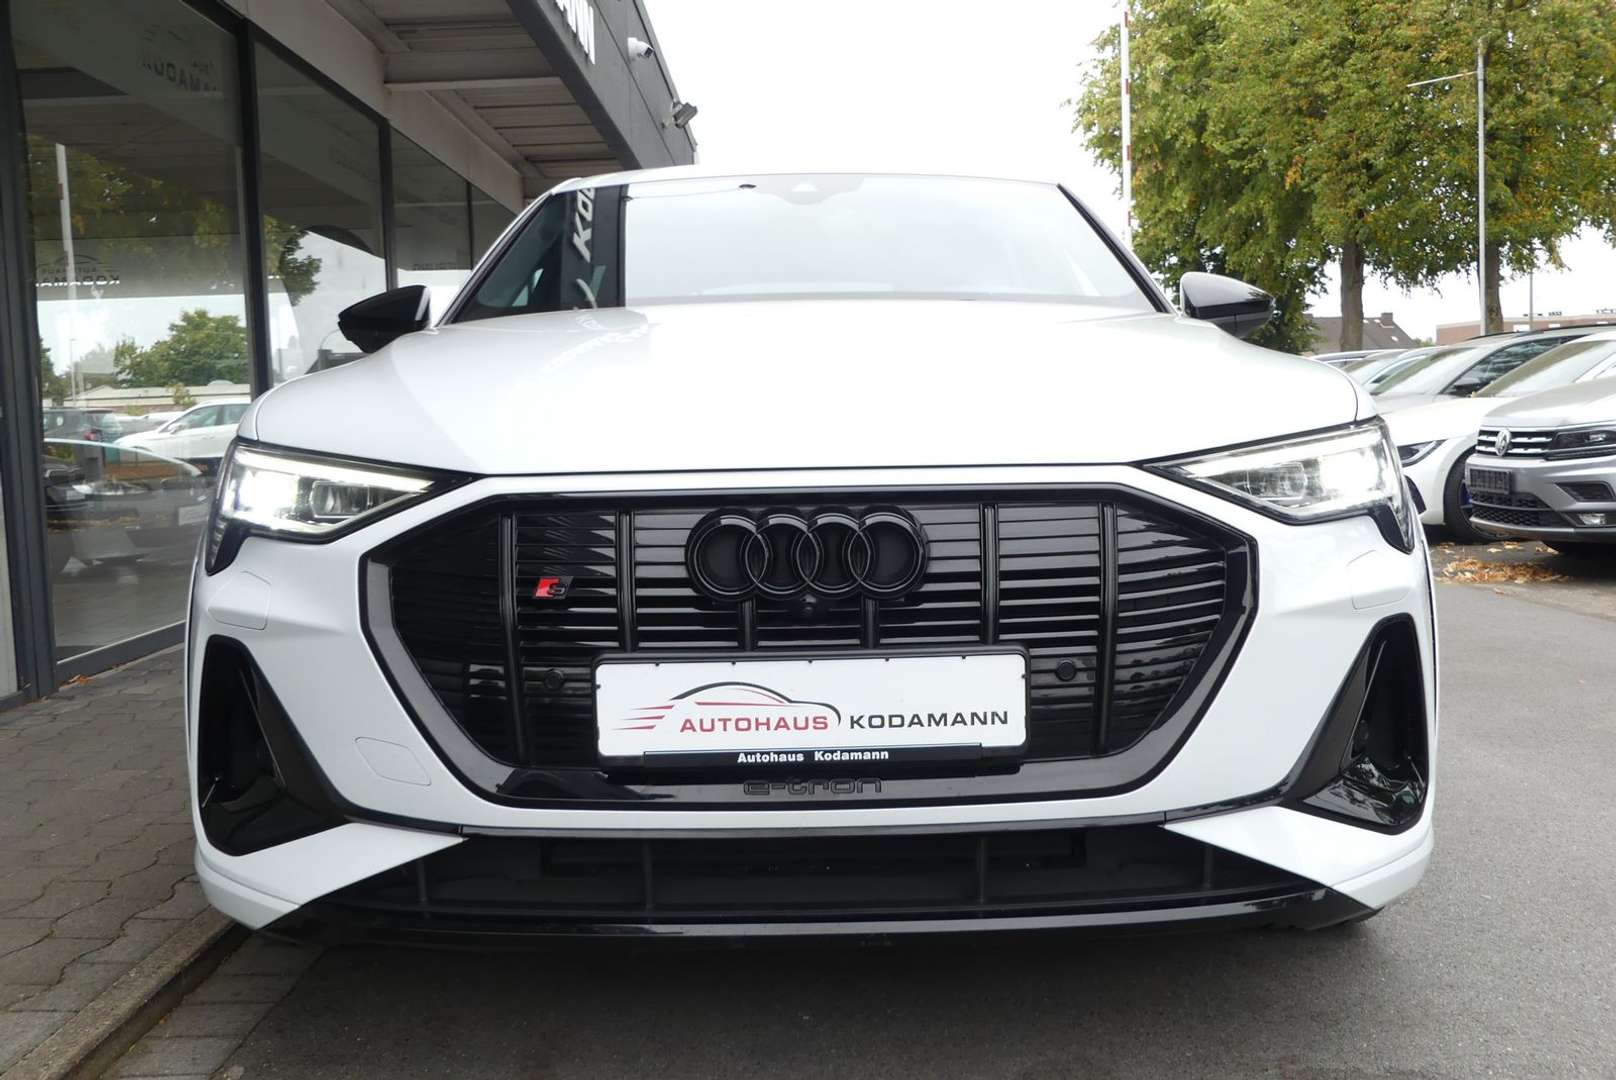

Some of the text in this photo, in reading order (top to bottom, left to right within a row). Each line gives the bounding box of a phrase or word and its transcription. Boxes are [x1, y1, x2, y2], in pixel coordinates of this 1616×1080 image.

[680, 711, 1009, 733] AUTOHAUS KODAMANN
[737, 750, 889, 763] Autohaus Kodamann
[743, 778, 882, 796] e-tron
